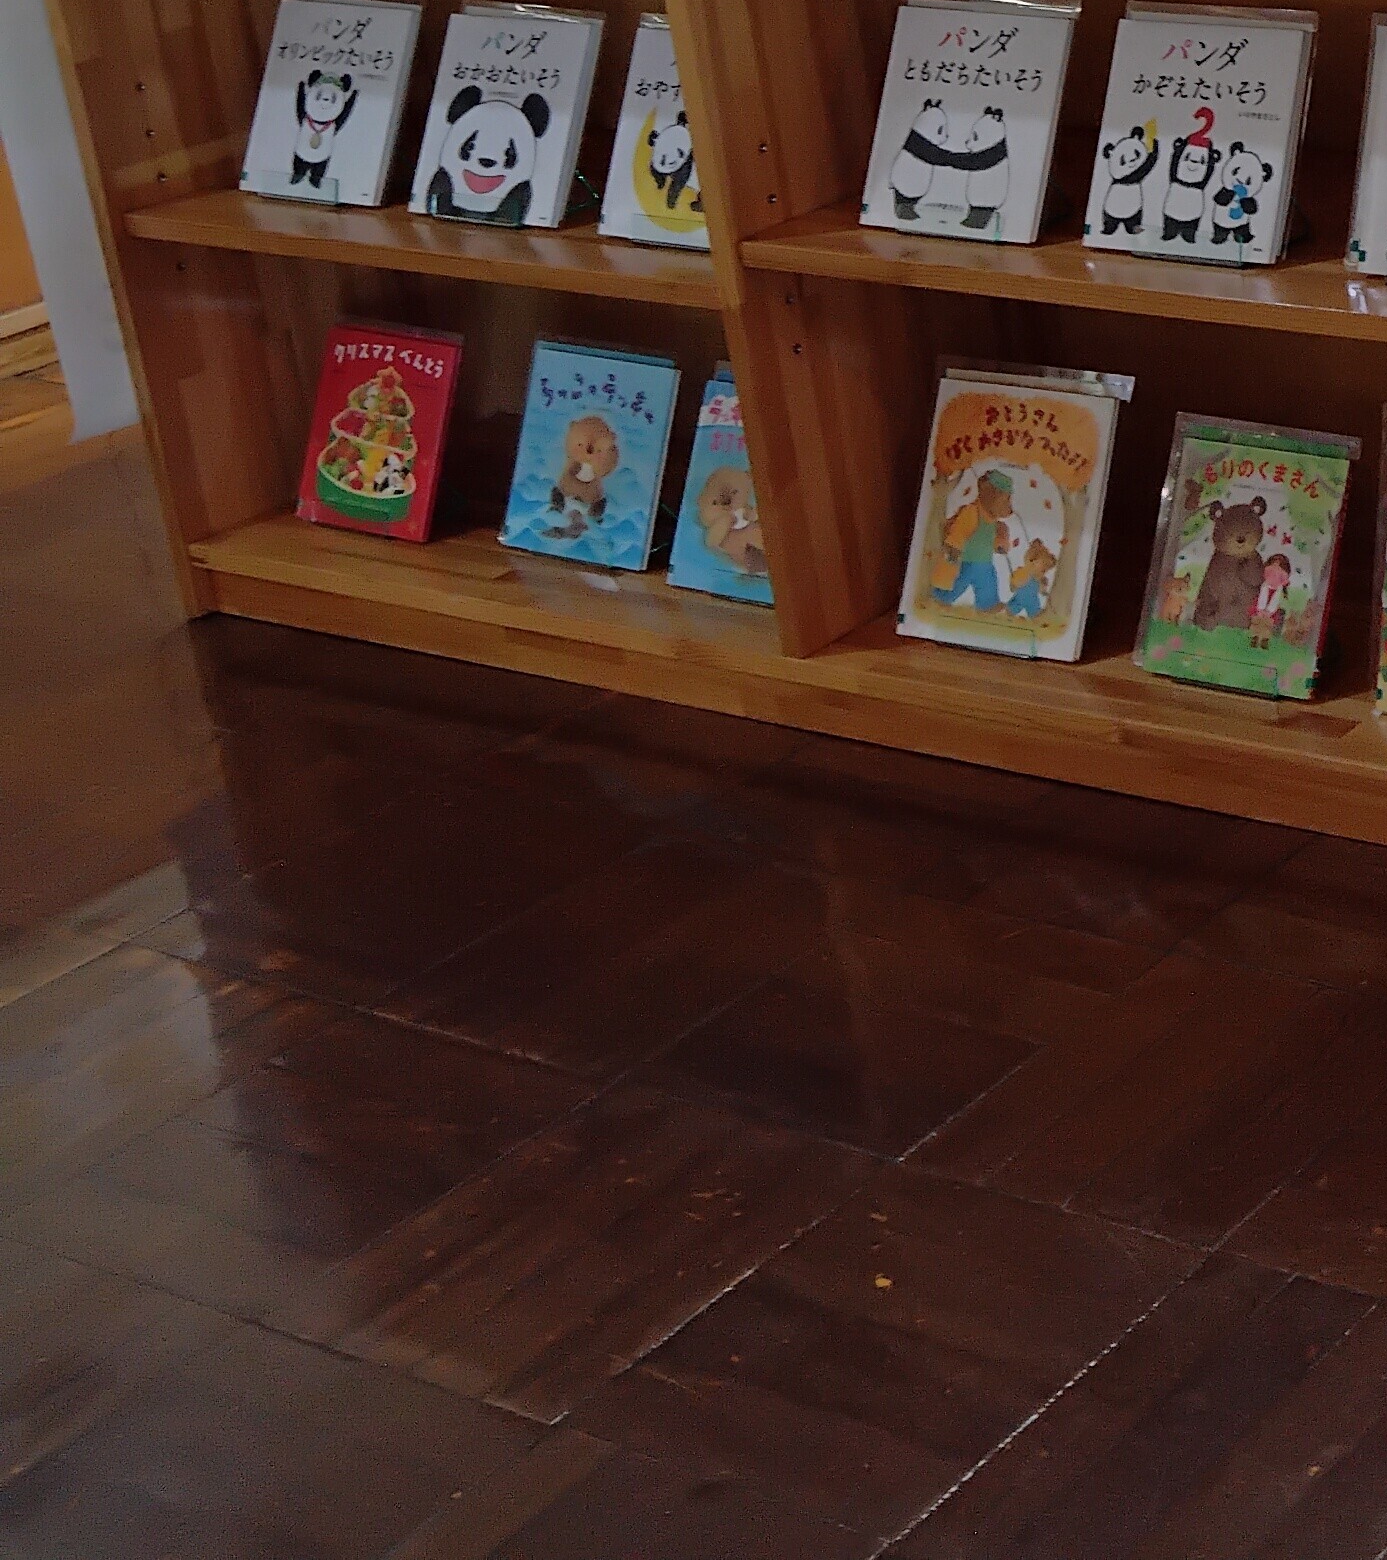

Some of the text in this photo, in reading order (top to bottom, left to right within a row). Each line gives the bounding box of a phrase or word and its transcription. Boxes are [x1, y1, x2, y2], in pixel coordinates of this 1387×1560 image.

[480, 30, 549, 60] パンダ
[939, 25, 1020, 59] パンダ
[1161, 38, 1250, 72] パンダ
[453, 62, 561, 90] おかおたいそう
[904, 58, 1044, 93] ともだちたいそう
[1131, 73, 1267, 105] かぞえたいそう
[1203, 459, 1321, 500] もりのくまさん
